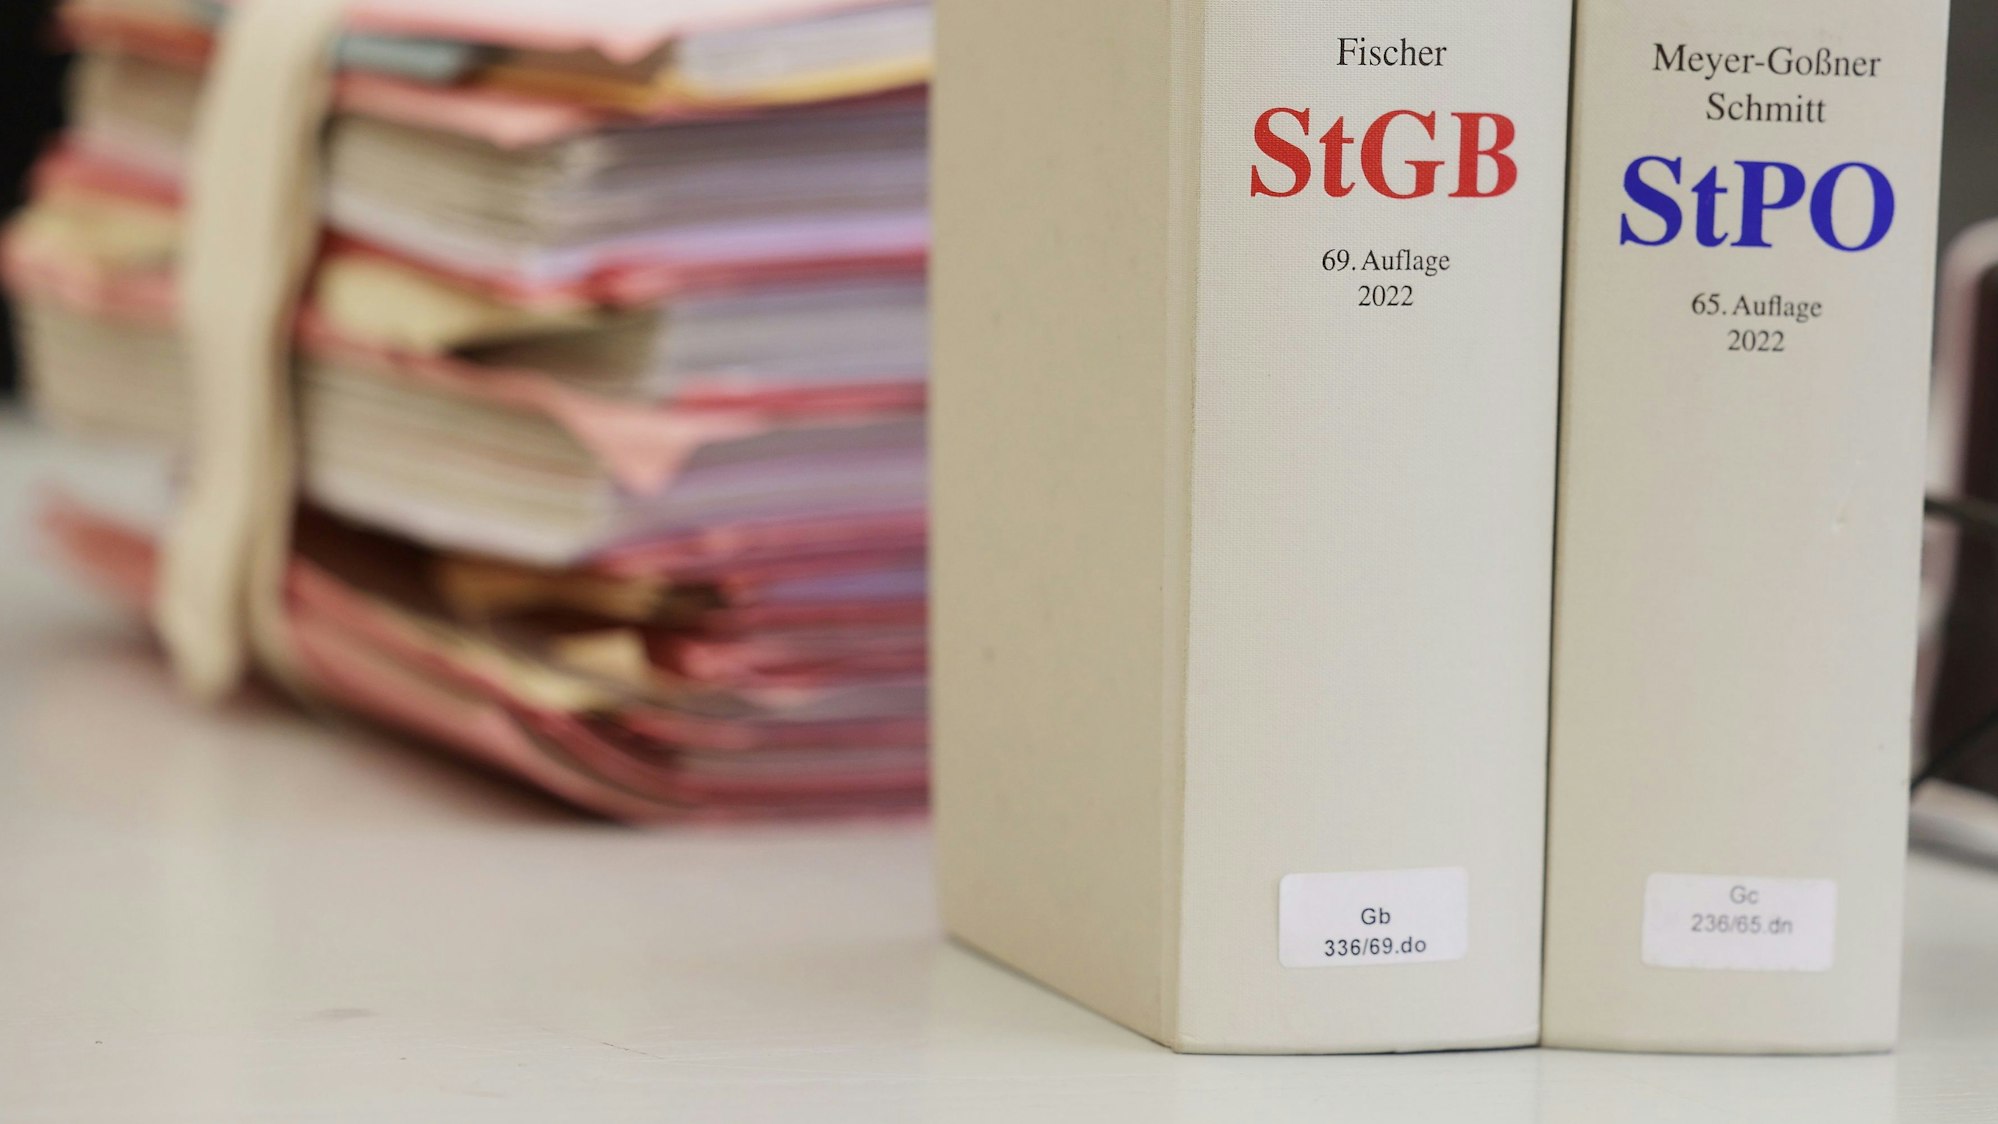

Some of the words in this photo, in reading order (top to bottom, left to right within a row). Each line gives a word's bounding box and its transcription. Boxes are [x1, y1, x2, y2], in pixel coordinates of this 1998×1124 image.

[1336, 36, 1448, 67] Fischer
[1652, 42, 1881, 81] Meyer-Goßner
[1706, 92, 1825, 123] Schmitt
[1251, 107, 1518, 199] StGB
[1620, 156, 1895, 252] StPO
[1322, 249, 1356, 272] 69.
[1360, 249, 1450, 277] Auflage
[1358, 284, 1413, 307] 2022
[1692, 293, 1727, 316] 65.
[1732, 295, 1823, 323] Auflage
[1728, 330, 1785, 352] 2022
[1729, 885, 1760, 905] Gc
[1361, 907, 1391, 926] Gb
[1691, 913, 1793, 934] 236/65.dn
[1324, 936, 1427, 957] 336/69.do
